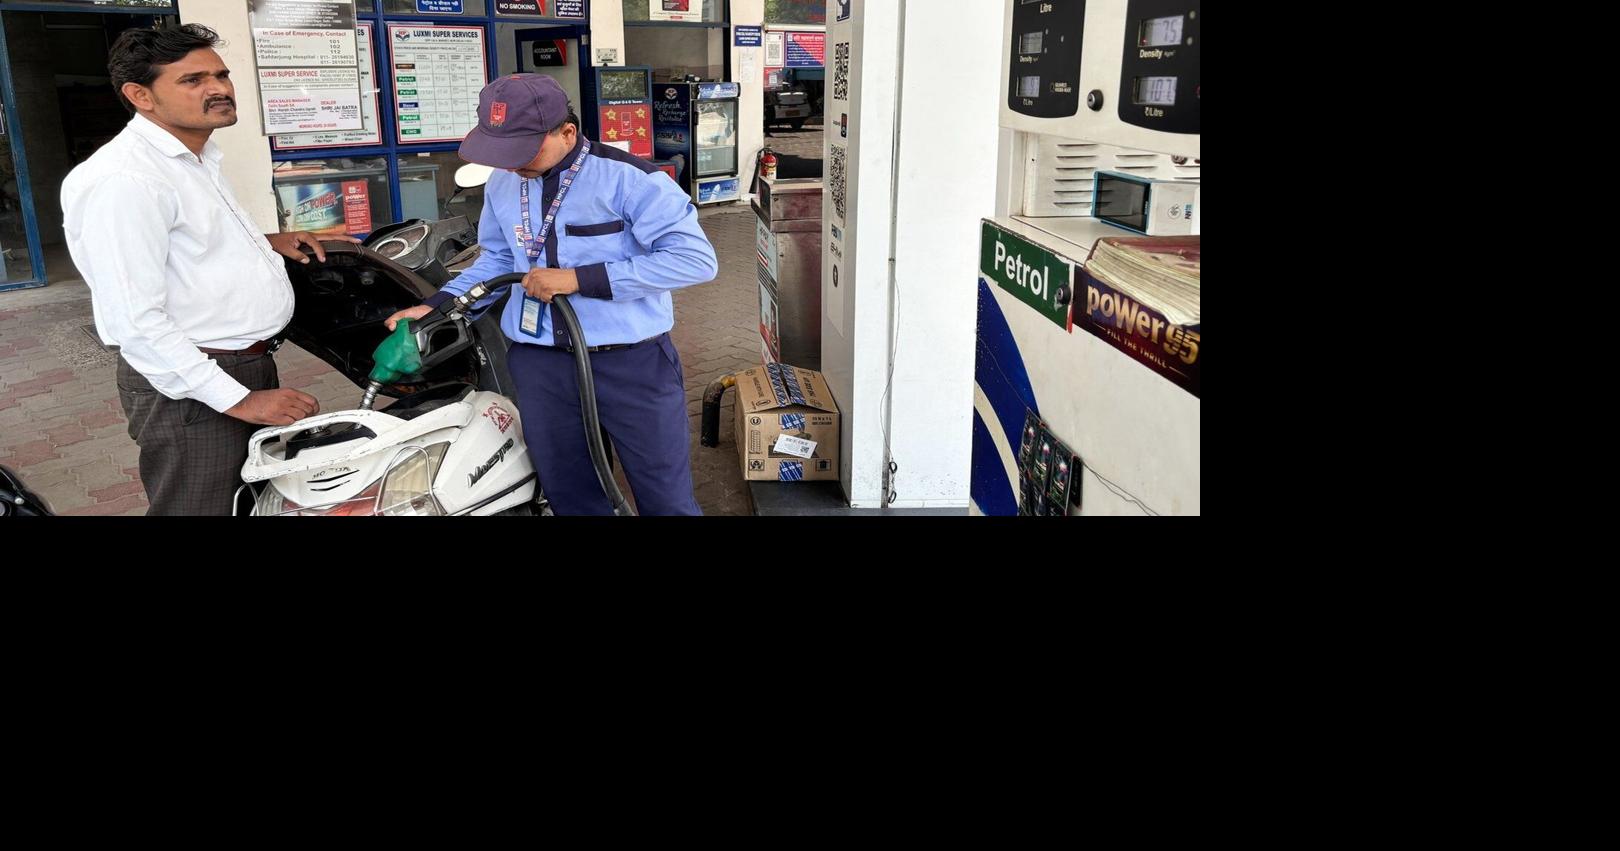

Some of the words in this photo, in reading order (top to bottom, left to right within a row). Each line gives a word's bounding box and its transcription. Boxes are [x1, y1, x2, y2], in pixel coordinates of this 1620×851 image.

[1040, 3, 1052, 13] Litre
[1140, 49, 1163, 59] Density
[654, 100, 681, 109] Refresh
[576, 150, 587, 166] HPCL
[556, 186, 568, 201] HPCL
[539, 222, 550, 238] HPCL
[994, 240, 1048, 301] Petrol
[1106, 330, 1121, 342] FILL
[1123, 336, 1138, 350] THE
[1140, 347, 1167, 368] THRILL
